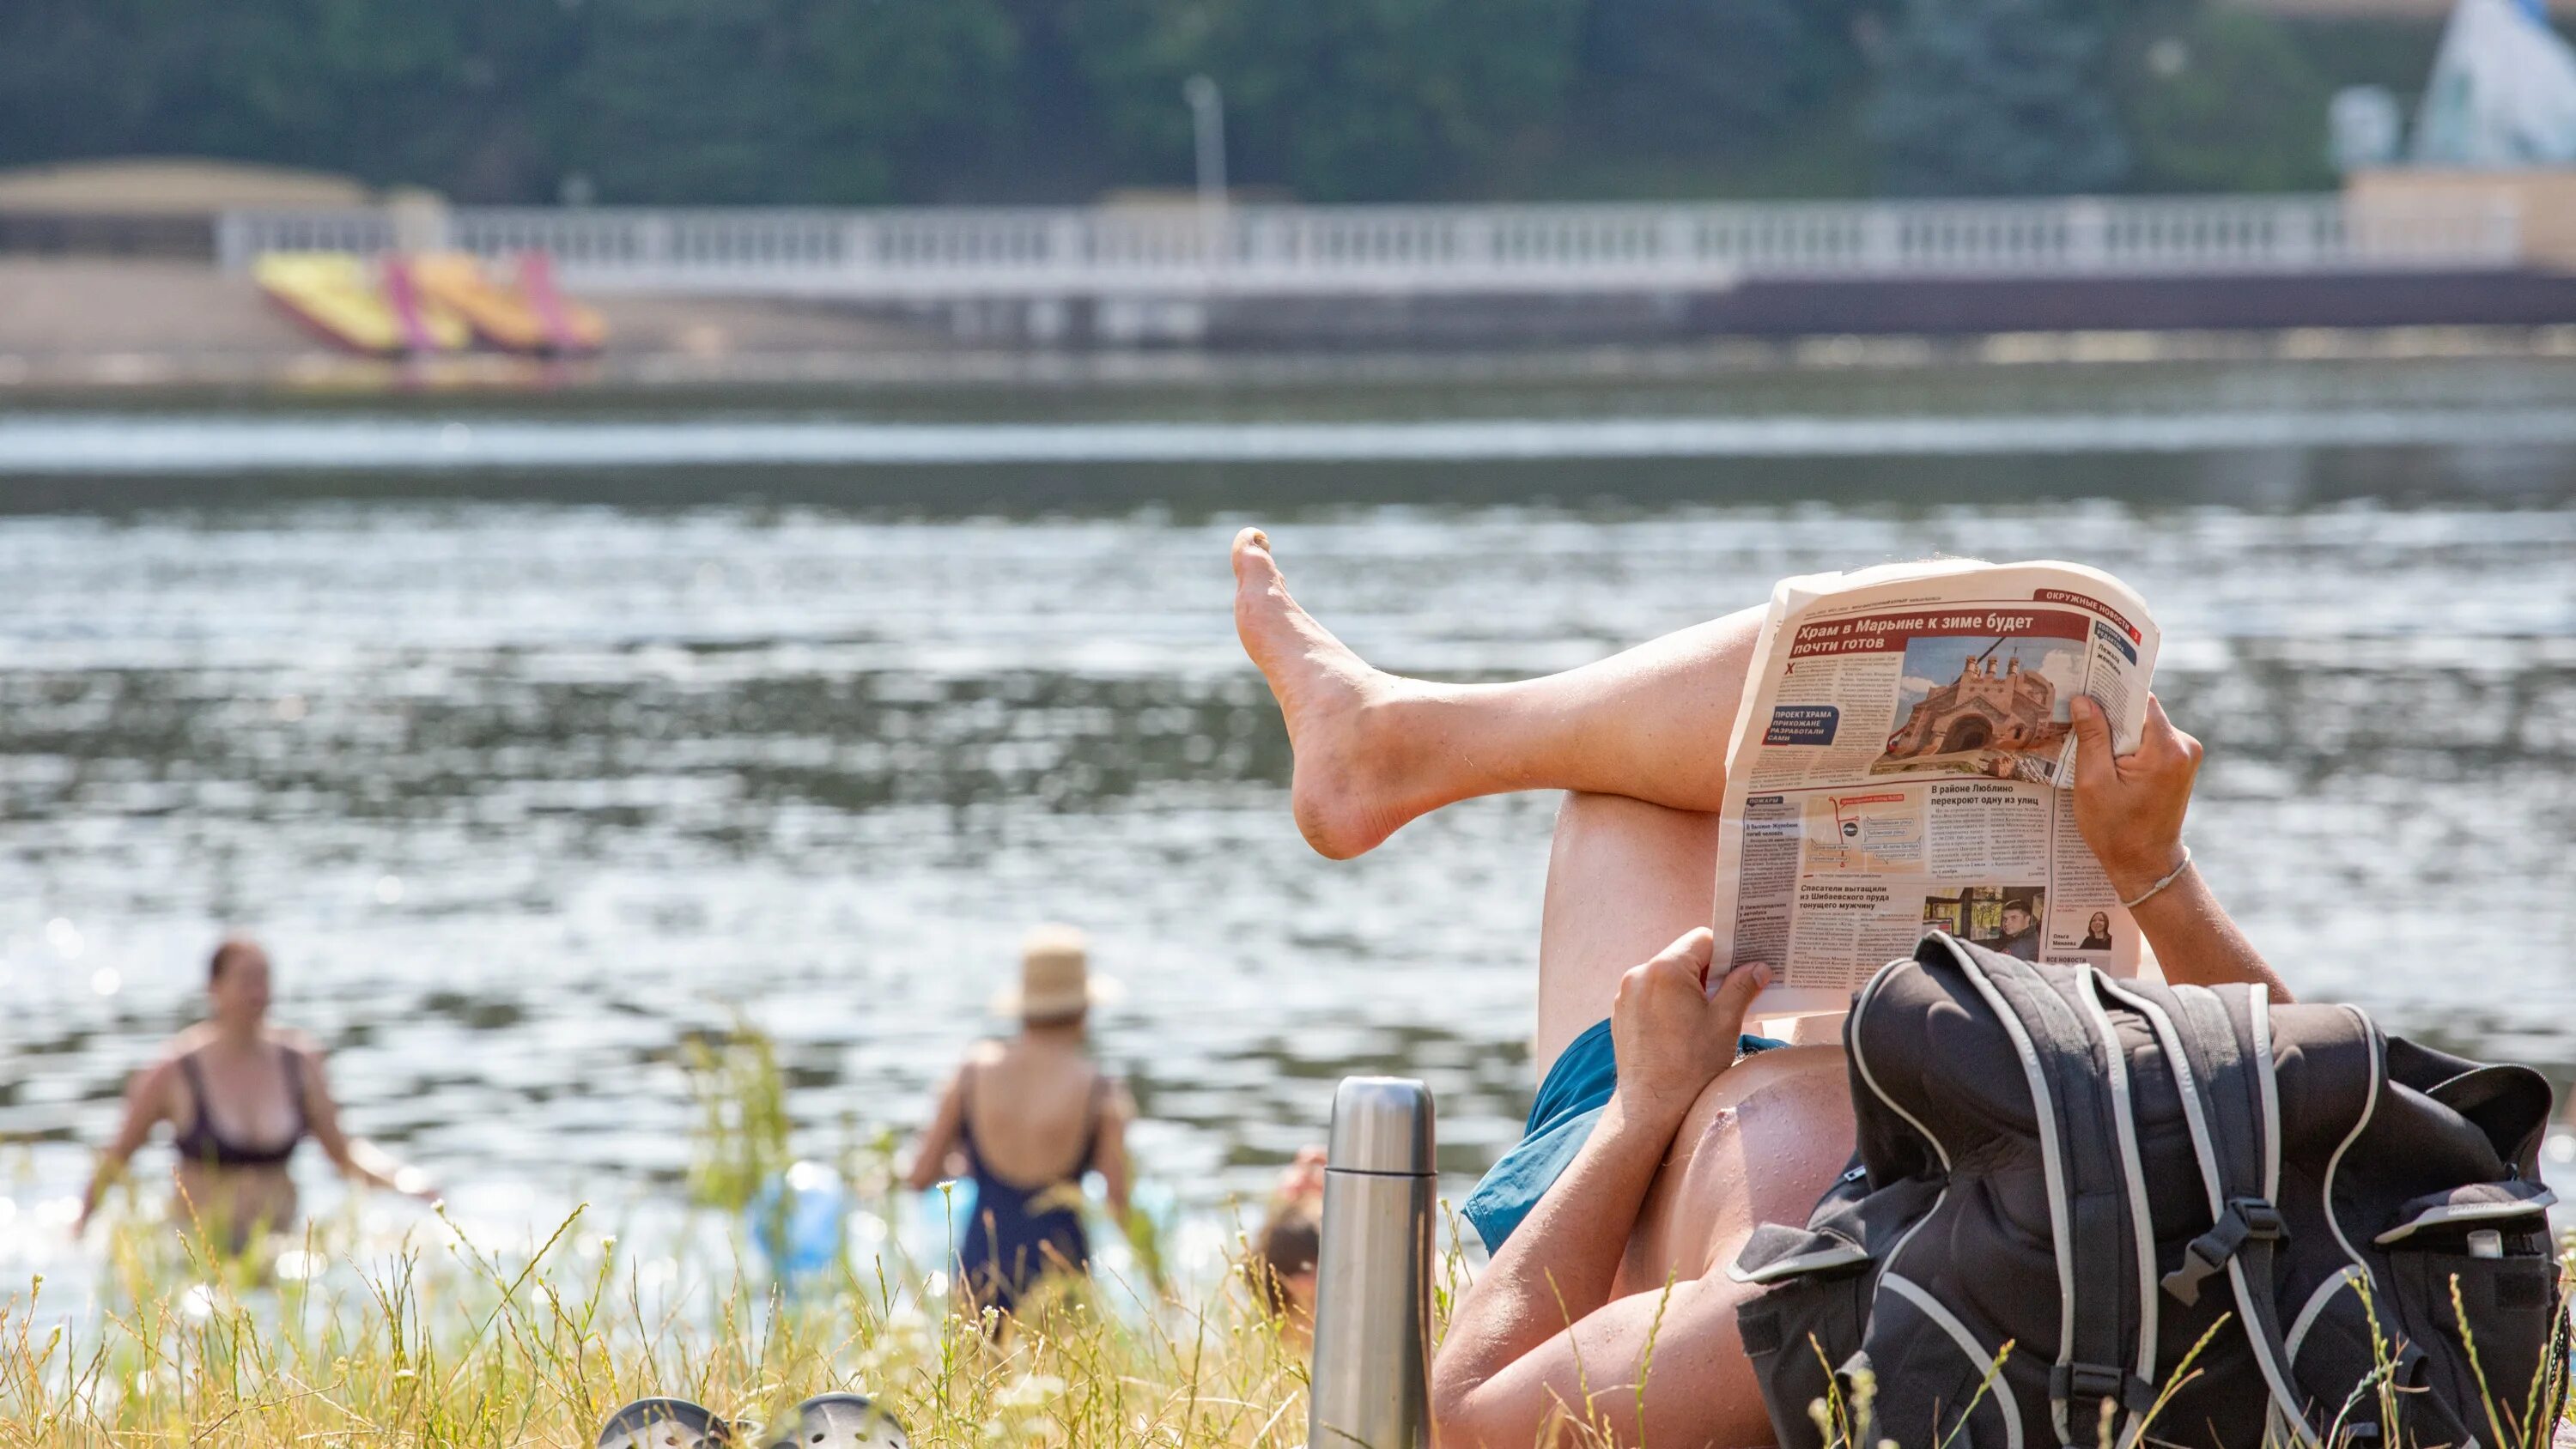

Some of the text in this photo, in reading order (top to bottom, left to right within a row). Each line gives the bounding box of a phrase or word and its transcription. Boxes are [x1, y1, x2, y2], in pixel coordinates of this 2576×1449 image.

[2046, 591, 2098, 609] ОКРУЖНЫЕ
[2099, 604, 2129, 631] НОВОСТИ
[1798, 612, 2033, 640] Храм в Марьине к зиме будет
[1794, 638, 1885, 655] почти готов
[1931, 783, 2014, 796] В районе Люблино
[1931, 796, 1979, 806] перекроют
[1981, 795, 2002, 806] одну
[2017, 796, 2038, 806] улиц
[1811, 893, 1864, 901] Шибаевского
[1800, 901, 1875, 911] тонущего мужчину
